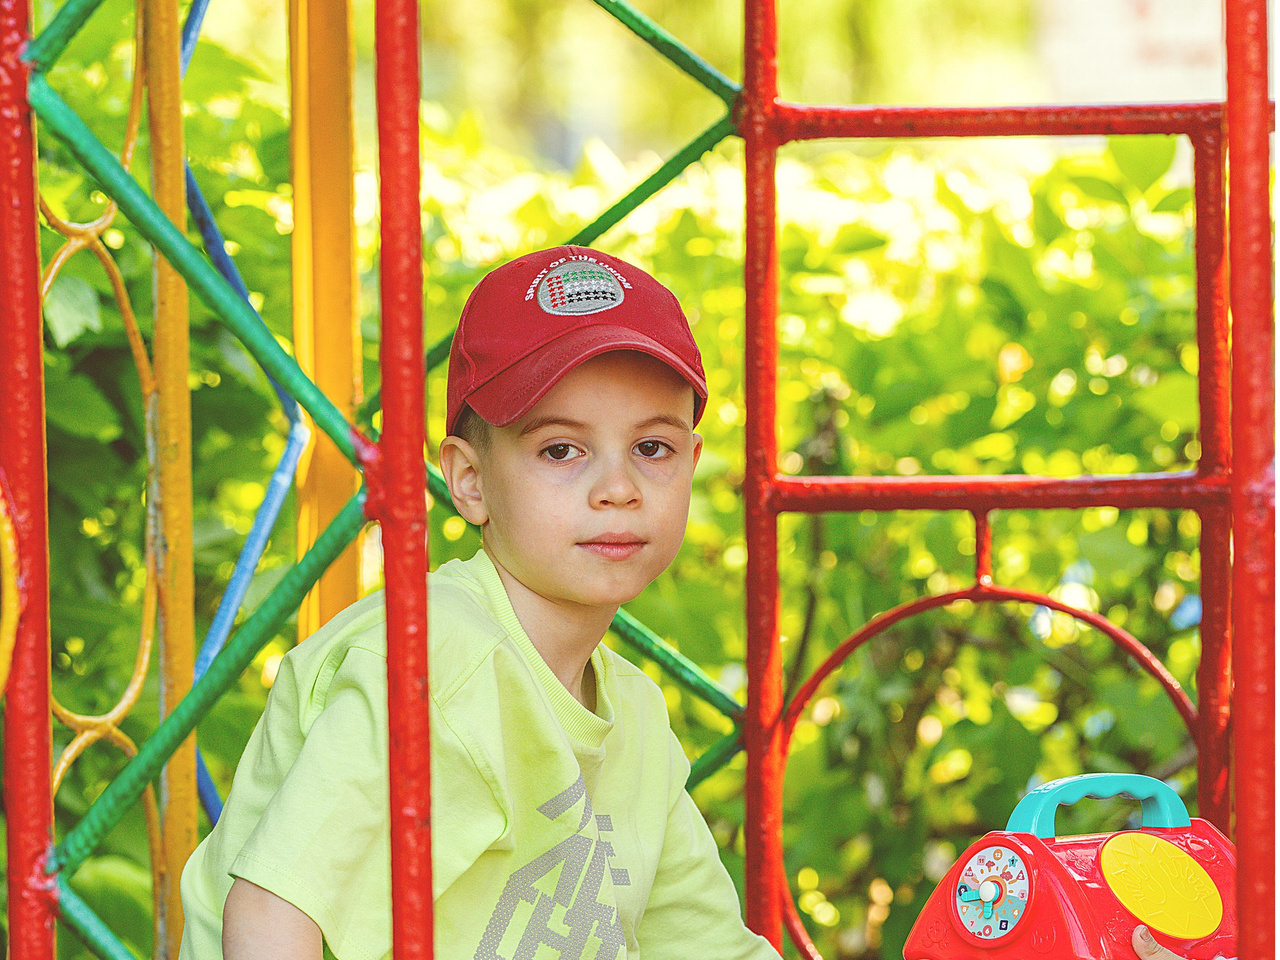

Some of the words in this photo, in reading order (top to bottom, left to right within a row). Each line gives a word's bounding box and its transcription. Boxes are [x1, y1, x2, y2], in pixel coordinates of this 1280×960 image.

[525, 268, 548, 301] SPIRIT
[550, 257, 567, 268] OF
[569, 255, 598, 263] THE
[599, 262, 633, 289] UNION
